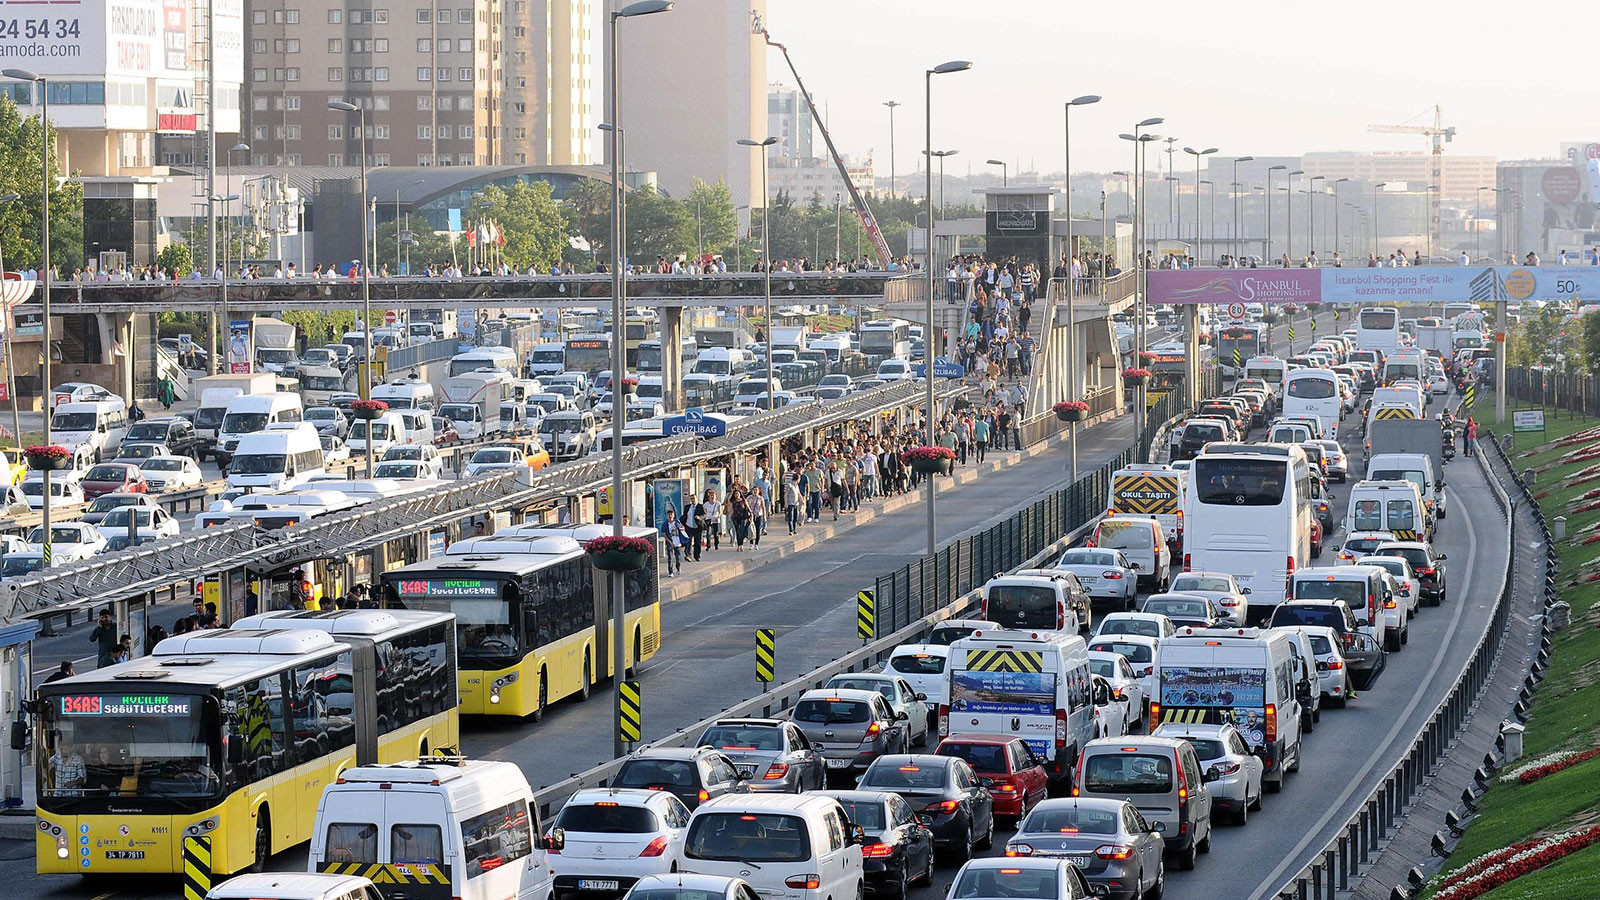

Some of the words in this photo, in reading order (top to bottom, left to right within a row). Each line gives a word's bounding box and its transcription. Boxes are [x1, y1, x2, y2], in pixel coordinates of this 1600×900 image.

[25, 19, 50, 39] 54
[55, 19, 80, 39] 34
[1335, 274, 1371, 284] İstanbul
[1373, 274, 1417, 286] Shopping
[1420, 274, 1440, 283] Fest
[1442, 273, 1454, 283] ile
[1355, 286, 1396, 295] kazanma
[671, 423, 718, 434] CEVİZLİBAĞ
[64, 696, 101, 713] 34AS
[107, 851, 116, 859] 34
[118, 851, 126, 859] TP
